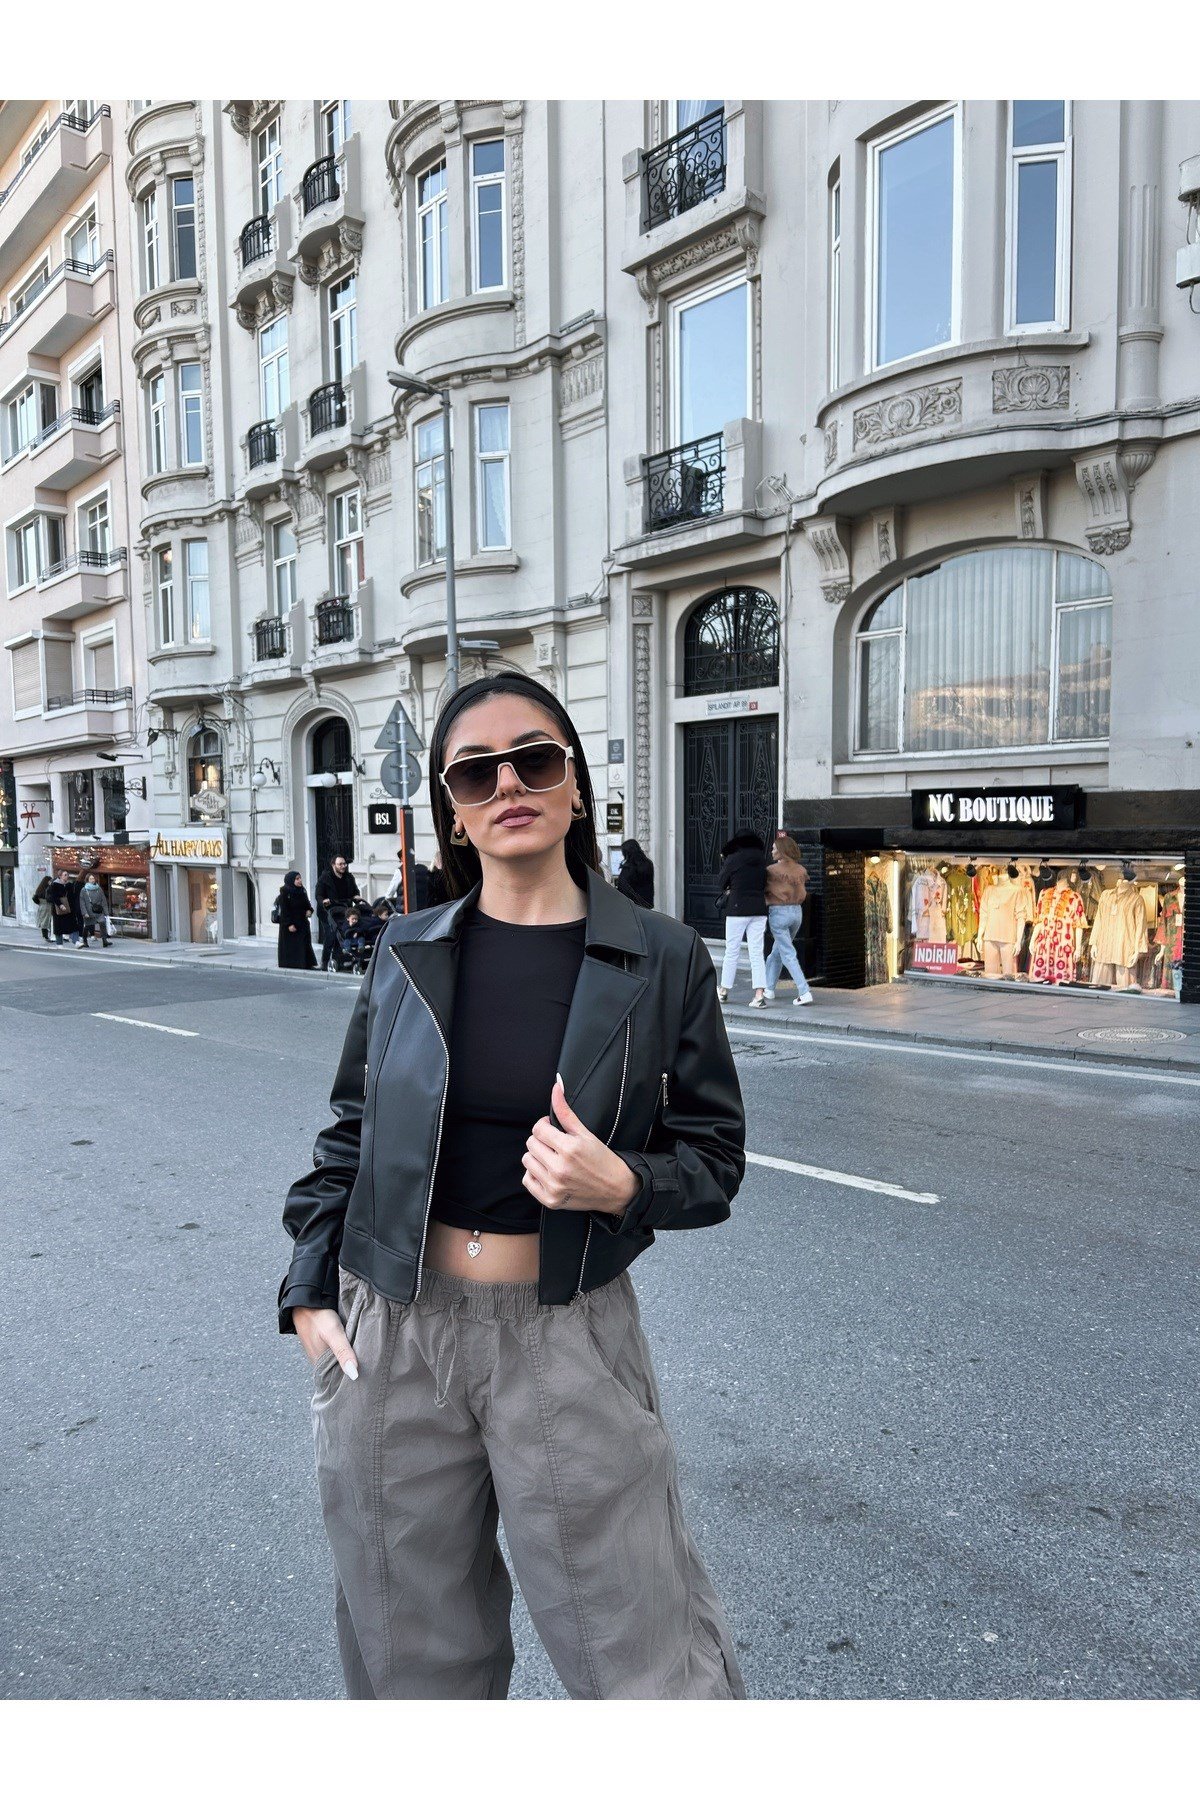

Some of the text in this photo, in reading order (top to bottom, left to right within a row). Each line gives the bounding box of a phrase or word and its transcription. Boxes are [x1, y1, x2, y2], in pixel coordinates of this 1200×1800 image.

[375, 812, 392, 825] BSL
[928, 793, 1054, 825] NC BOUTIQUE
[201, 840, 223, 858] DAYS
[914, 943, 957, 964] İNDİRİM
